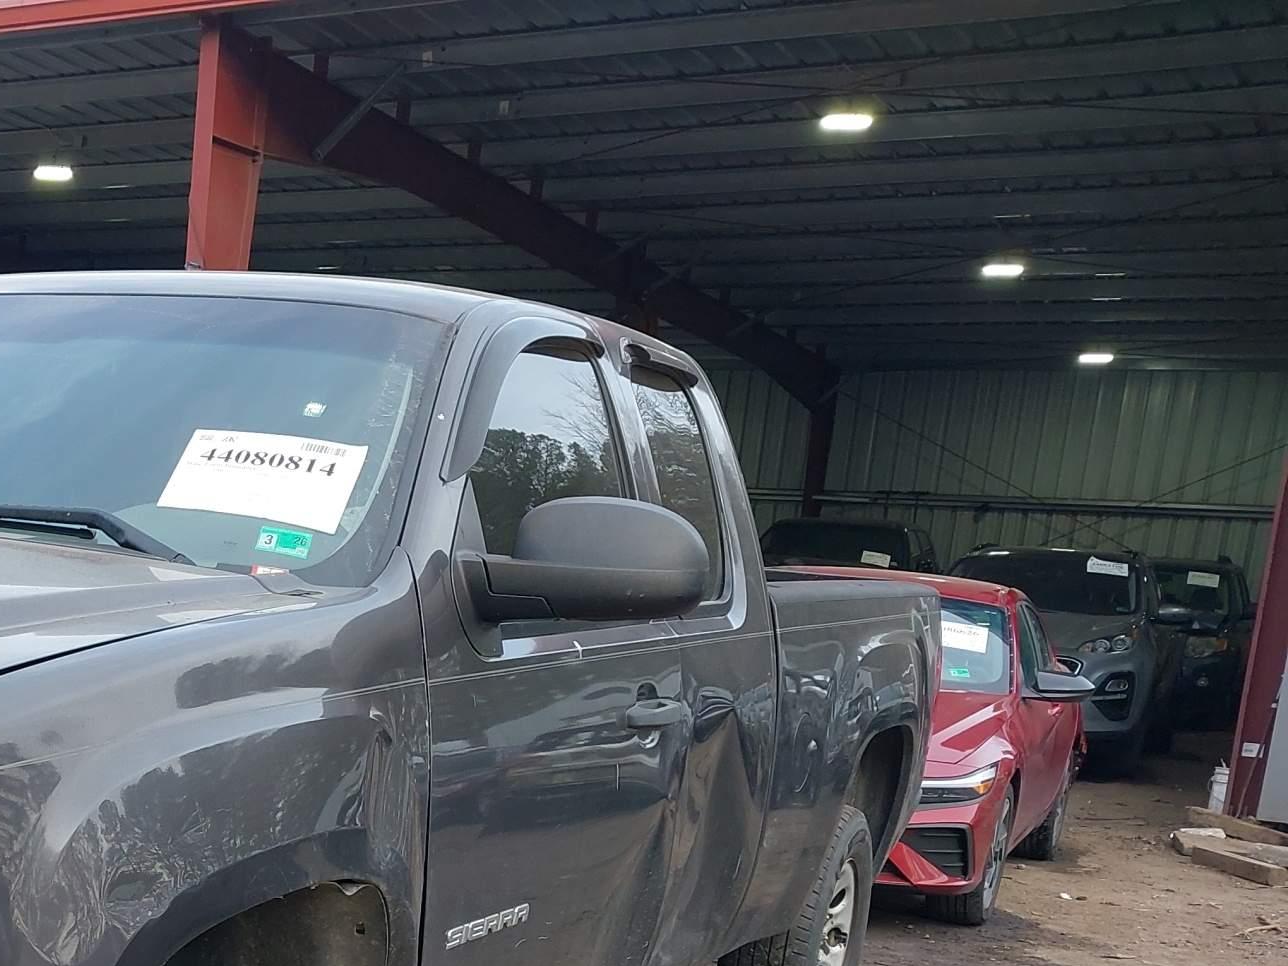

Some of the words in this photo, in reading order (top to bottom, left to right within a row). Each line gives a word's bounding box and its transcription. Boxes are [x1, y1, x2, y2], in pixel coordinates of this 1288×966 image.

[199, 447, 338, 477] 44080814
[264, 534, 274, 545] 3
[445, 902, 530, 950] SIERRA
